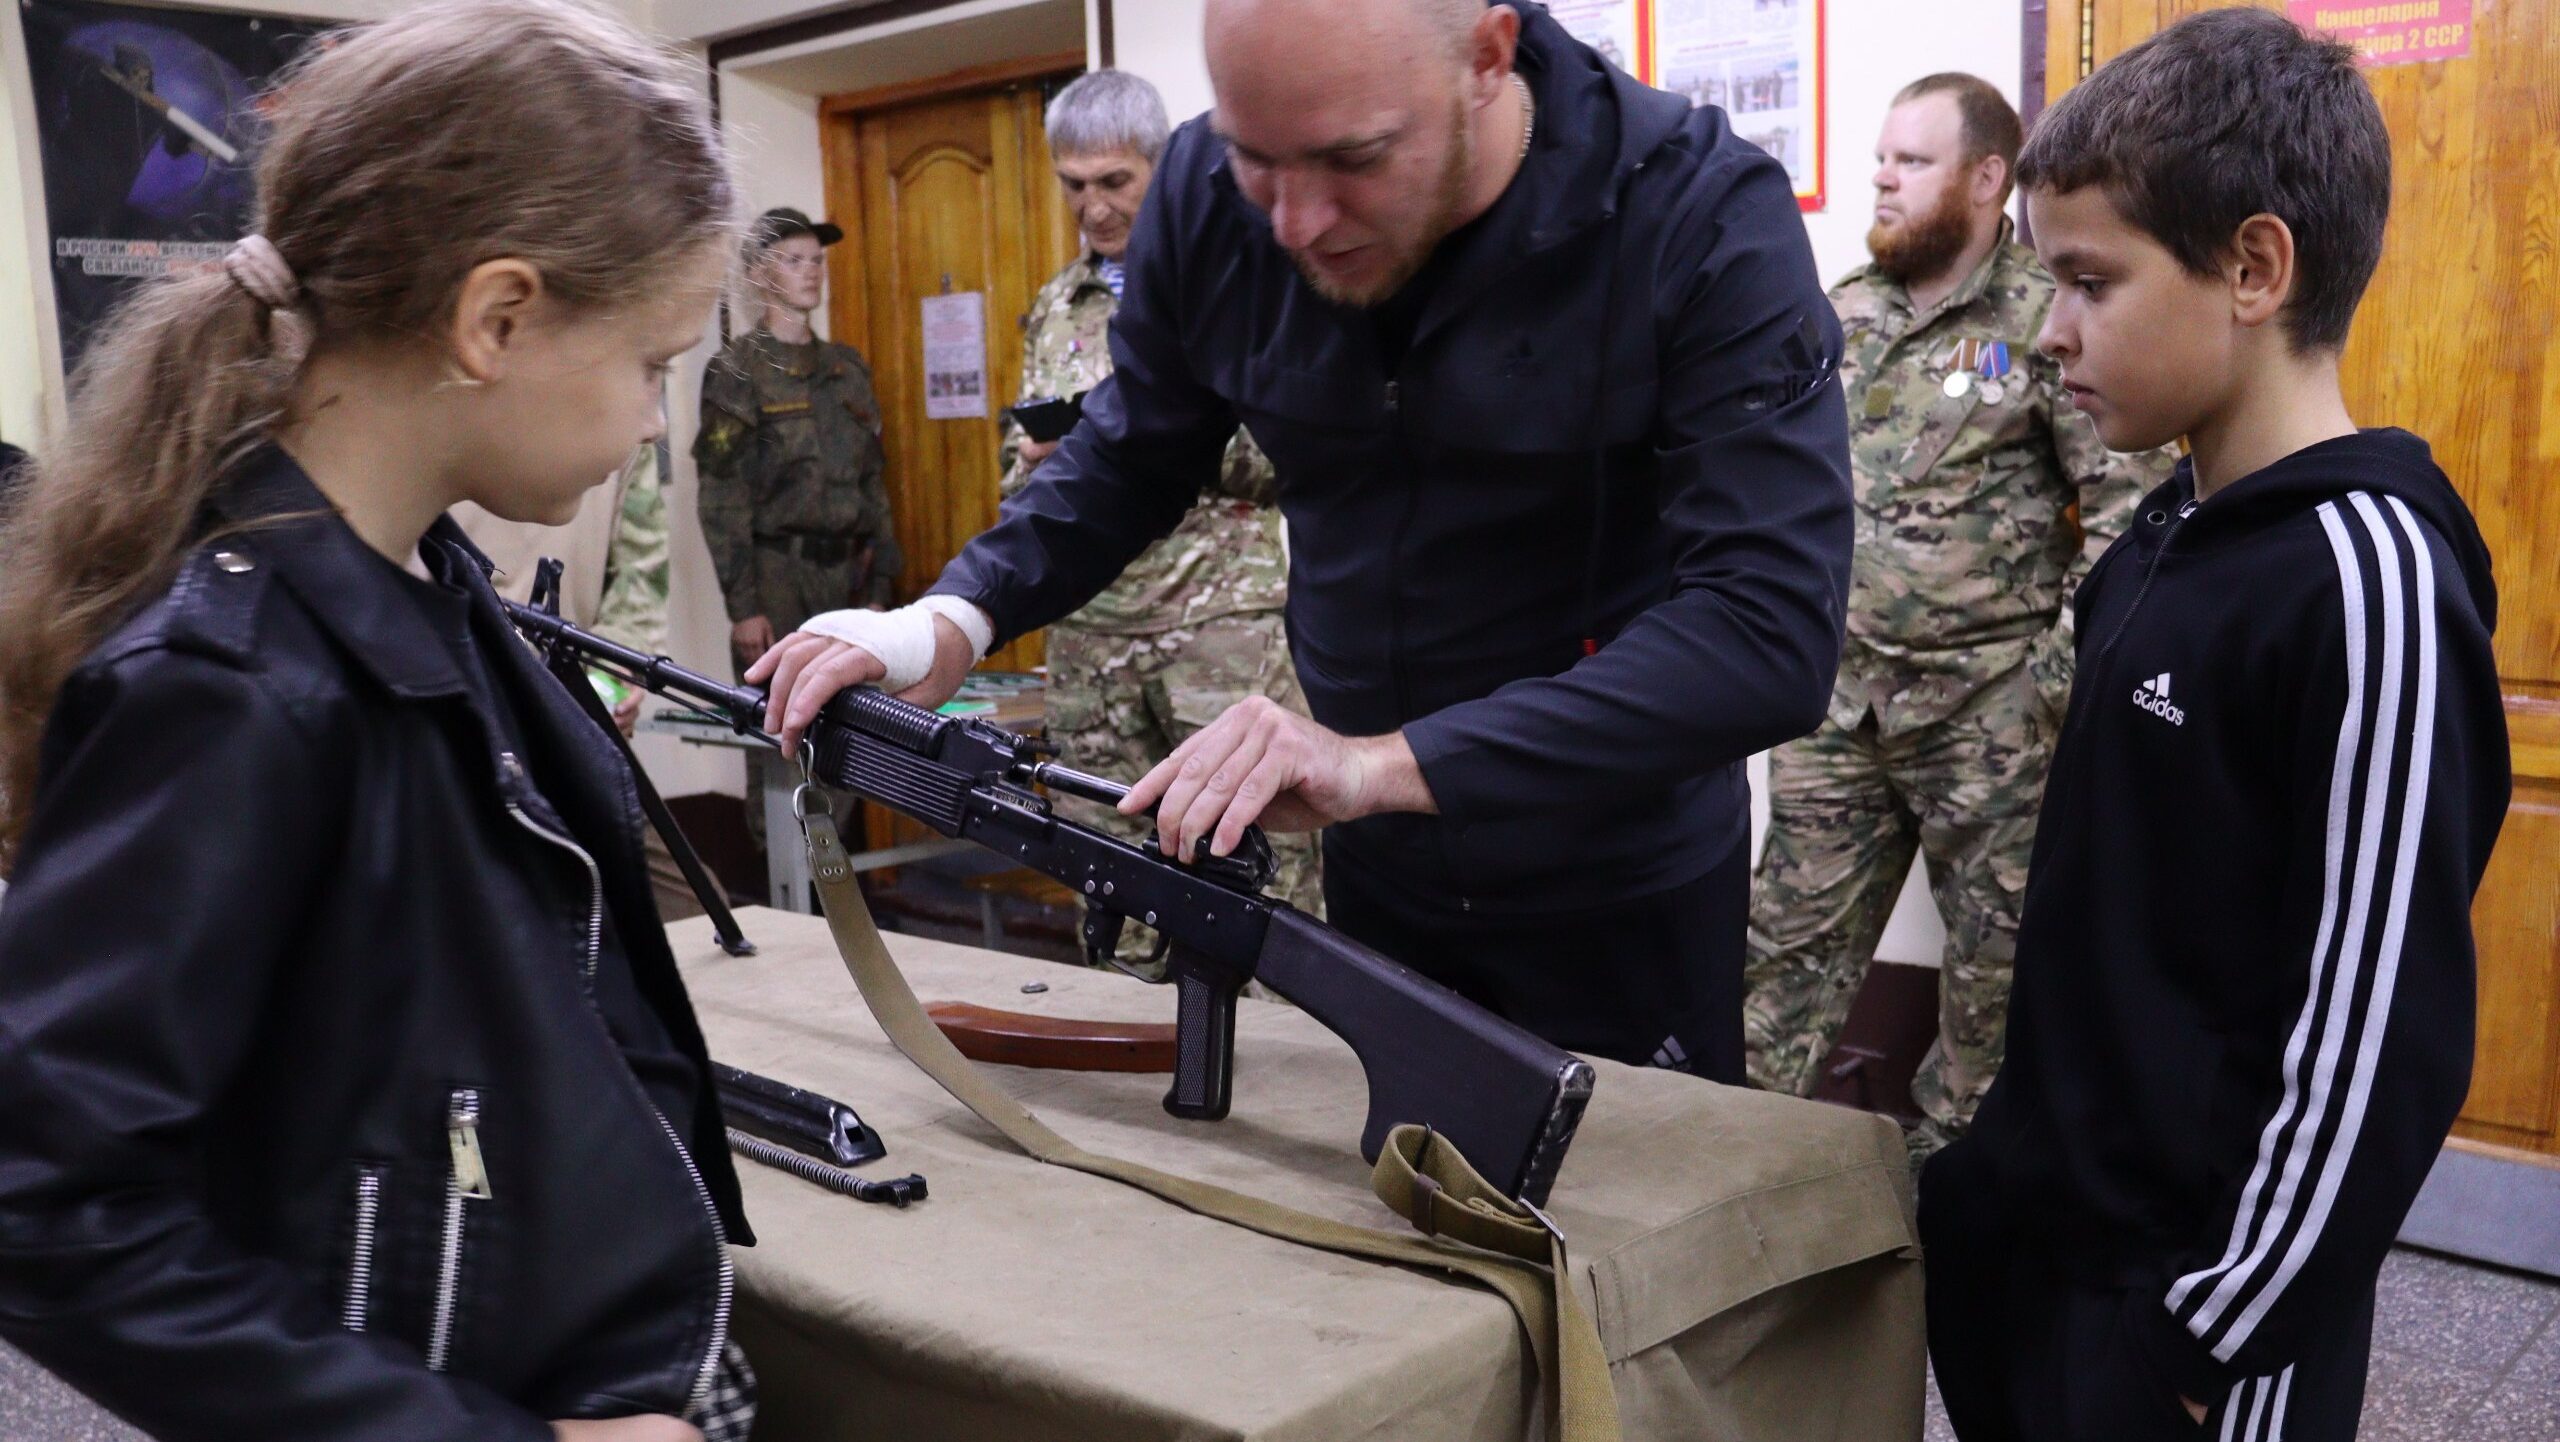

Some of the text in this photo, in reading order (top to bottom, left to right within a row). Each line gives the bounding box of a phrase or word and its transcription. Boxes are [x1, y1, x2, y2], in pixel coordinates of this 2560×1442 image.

[2315, 1, 2440, 28] Канцелярия
[2408, 28, 2421, 49] 2
[2423, 24, 2465, 48] ССР
[2132, 689, 2185, 726] adidas
